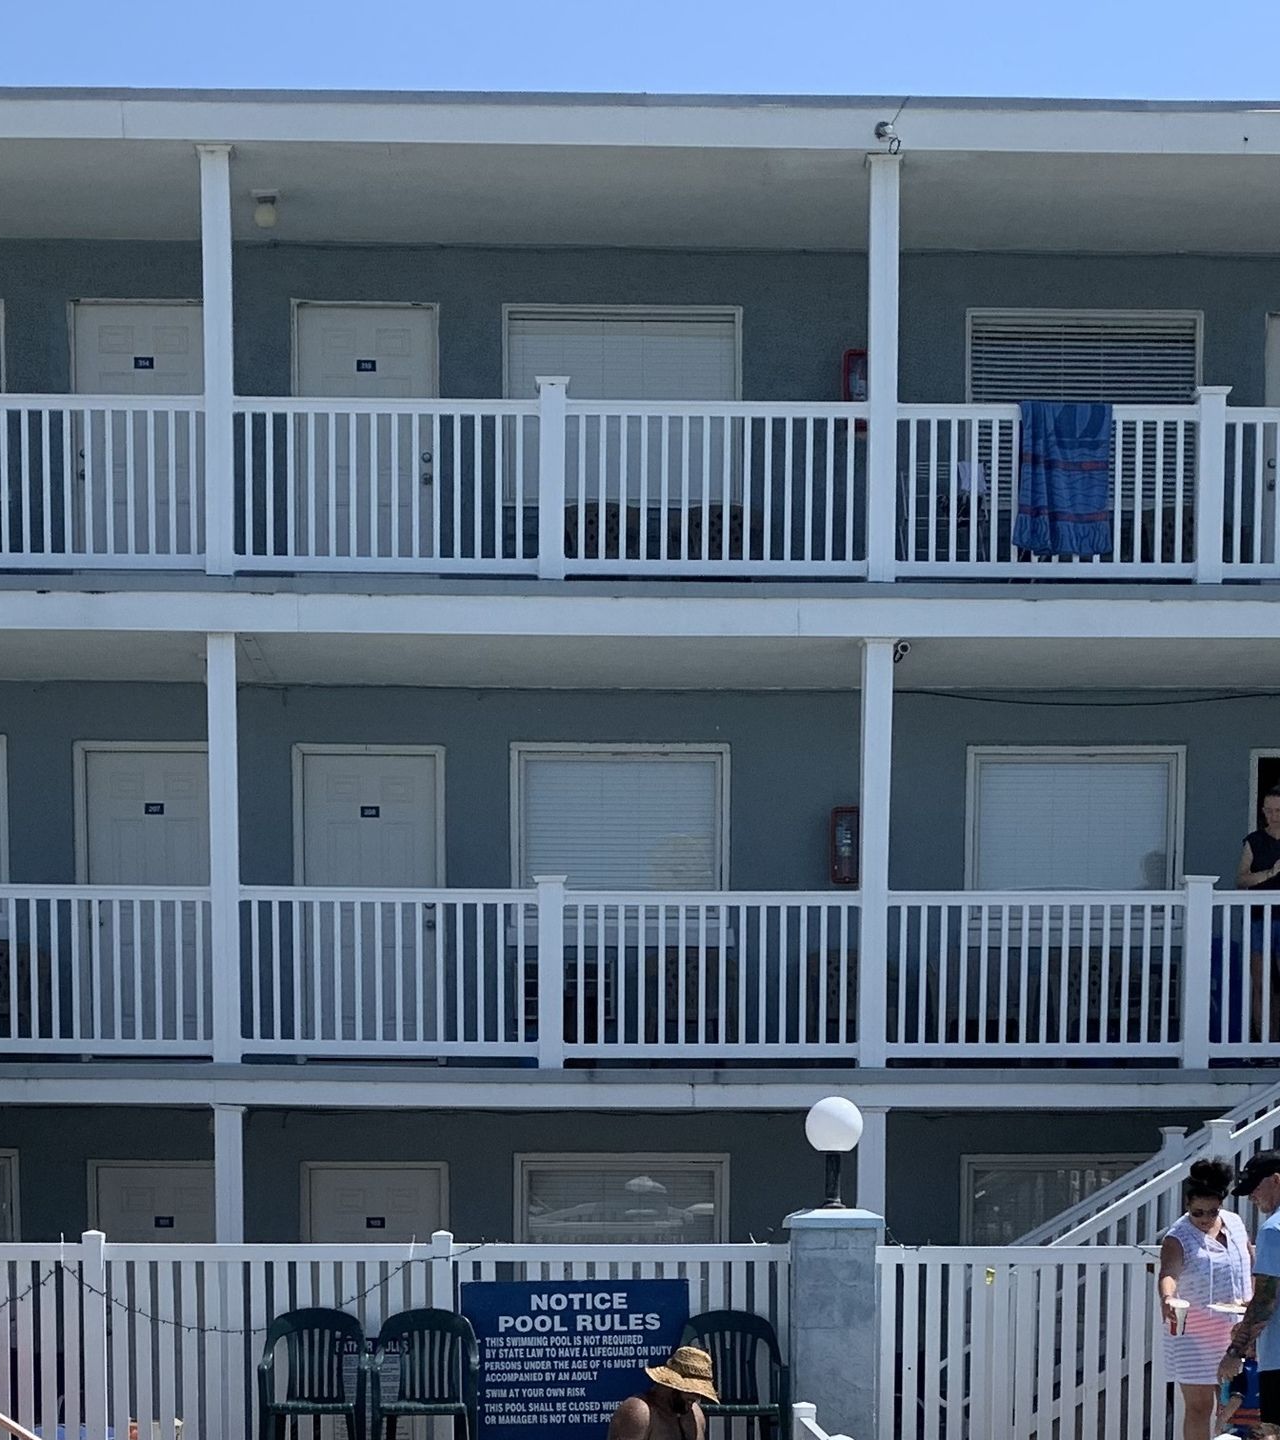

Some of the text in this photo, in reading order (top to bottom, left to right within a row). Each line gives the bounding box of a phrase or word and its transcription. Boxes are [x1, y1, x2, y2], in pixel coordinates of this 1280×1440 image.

[530, 1292, 628, 1311] NOTICE
[498, 1313, 661, 1333] POOL RULES
[485, 1335, 643, 1347] THIS SWIMMING POOL IS NOT REQUIRED
[485, 1346, 672, 1359] BY STATE LAW TO HAVE A LIFEGUARD ON DUTY
[484, 1359, 649, 1371] PERSONS UNDER THE AGE OF 16 MUST BE
[485, 1371, 598, 1382] ACCOMPANIED BY AN ADULT
[485, 1387, 586, 1398] SWIM AT YOUR OWN RISK
[484, 1403, 504, 1413] THIS
[505, 1402, 527, 1413] POOL
[528, 1402, 554, 1412] SHALL
[556, 1402, 567, 1412] BE
[568, 1401, 600, 1411] CLOSED
[484, 1415, 497, 1425] OR
[498, 1414, 538, 1424] MANAGER
[539, 1414, 548, 1424] IS
[549, 1414, 567, 1424] NOT
[568, 1413, 581, 1423] ON
[582, 1413, 598, 1423] THE
